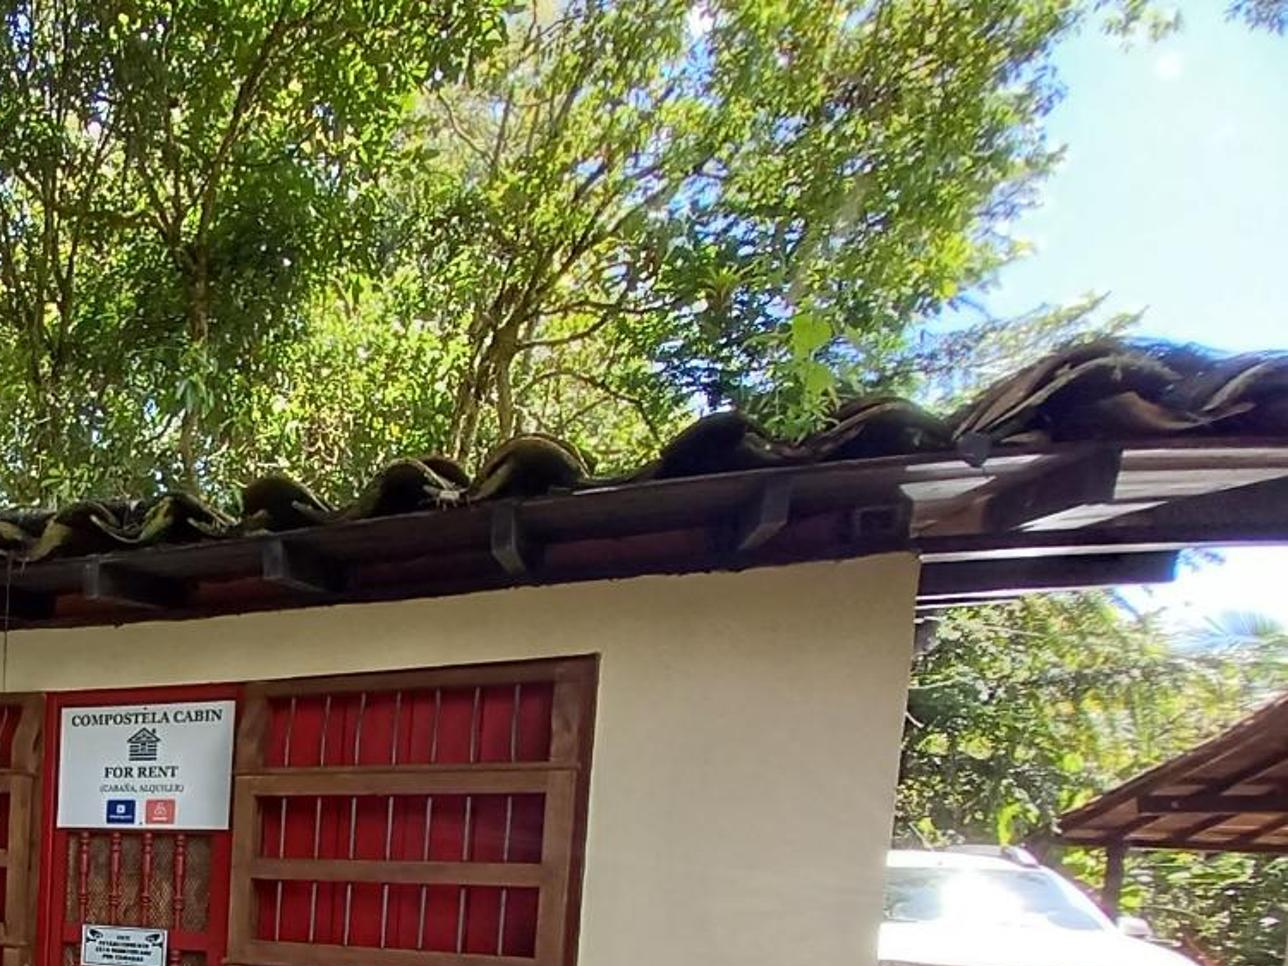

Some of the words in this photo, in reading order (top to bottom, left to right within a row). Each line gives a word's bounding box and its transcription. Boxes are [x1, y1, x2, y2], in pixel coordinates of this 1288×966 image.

[72, 712, 169, 727] COMPOSTELA
[173, 709, 223, 723] CABIN
[104, 767, 133, 778] FOR
[137, 766, 179, 778] RENT
